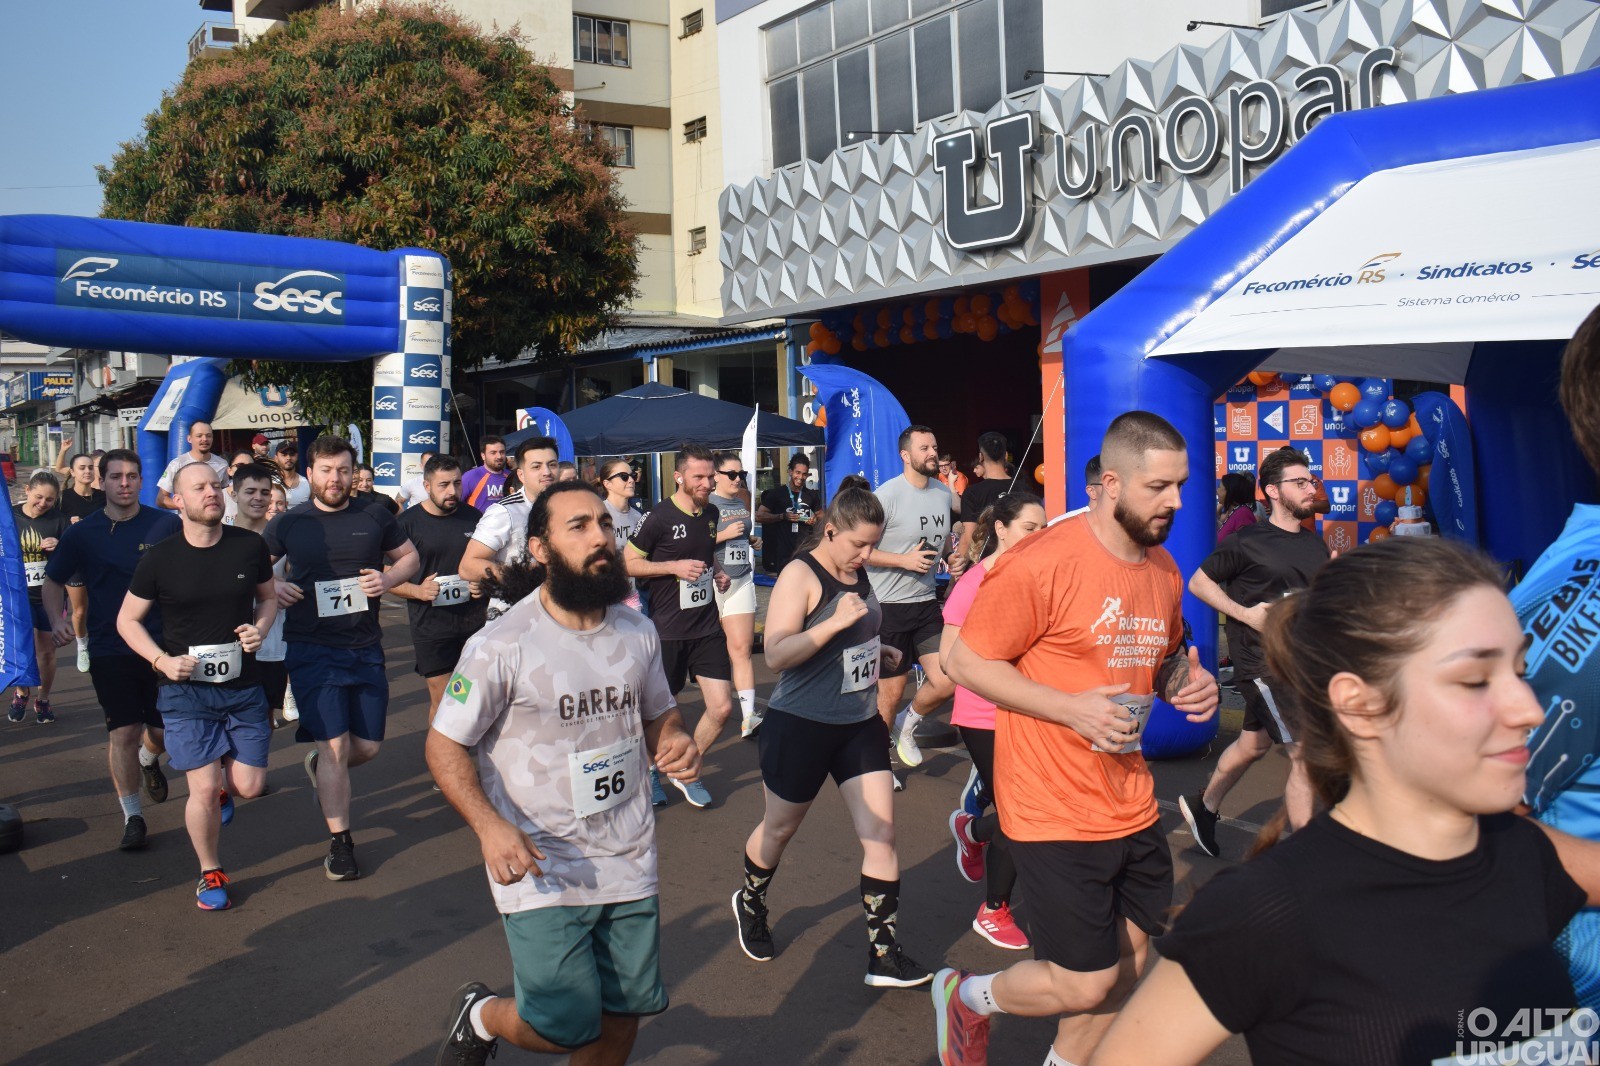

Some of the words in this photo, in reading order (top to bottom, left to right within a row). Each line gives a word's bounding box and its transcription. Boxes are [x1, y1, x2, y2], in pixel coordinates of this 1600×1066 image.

[1054, 46, 1397, 196] unopar
[1242, 272, 1353, 296] Fecomércio
[1357, 269, 1386, 285] RS
[1417, 261, 1533, 281] Sindicatos
[76, 281, 194, 305] Fecomércio
[200, 290, 227, 308] RS
[252, 275, 343, 316] Sesc
[1397, 297, 1452, 308] Sistema
[1456, 291, 1520, 305] Comércio
[413, 298, 441, 312] Sesc
[410, 366, 438, 379] Sesc
[375, 398, 398, 411] Sesc
[408, 432, 437, 445] Sesc
[851, 431, 863, 457] Sesc
[374, 464, 396, 477] Sesc
[1228, 463, 1256, 472] unopar
[1330, 503, 1357, 514] nopar
[672, 523, 687, 540] 23
[729, 550, 747, 561] 139
[323, 585, 341, 594] Sesc
[442, 587, 460, 600] 10
[691, 588, 707, 603] 60
[330, 593, 352, 610] 71
[1118, 613, 1166, 633] RÚSTICA
[1095, 634, 1112, 645] 20
[1112, 634, 1136, 645] ANOS
[197, 652, 217, 660] Sesc
[1112, 645, 1161, 657] FREDERICO
[203, 660, 230, 677] 80
[851, 657, 877, 683] 147
[582, 758, 610, 774] Sesc
[594, 769, 626, 801] 56
